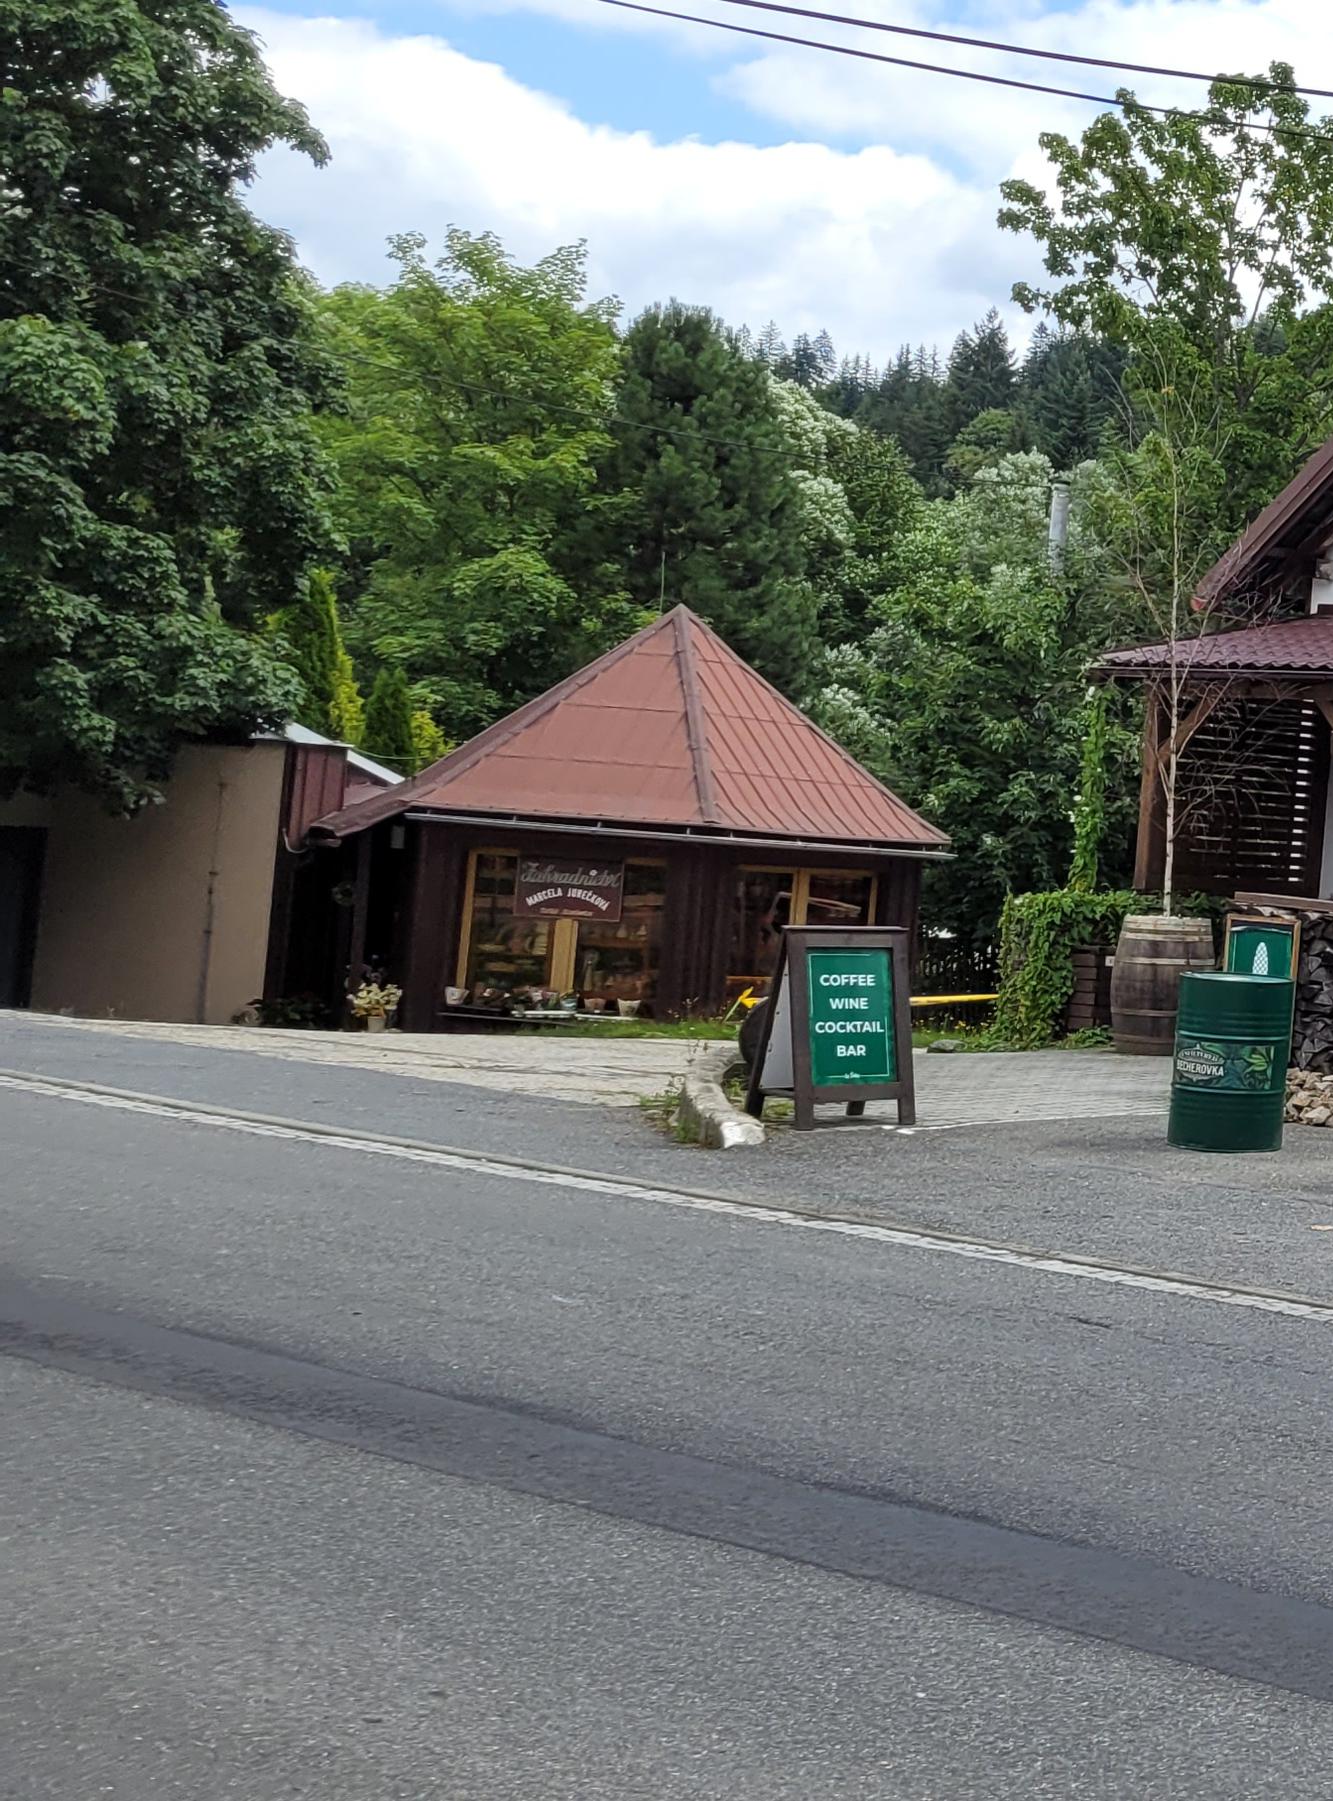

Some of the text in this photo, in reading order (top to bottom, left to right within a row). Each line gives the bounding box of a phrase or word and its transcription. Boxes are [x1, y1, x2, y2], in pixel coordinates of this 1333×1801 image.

[525, 887, 563, 907] MARCELA
[819, 974, 876, 987] COFFEE
[829, 998, 870, 1010] WINE
[814, 1021, 885, 1034] COCKTAIL
[836, 1045, 867, 1057] BAR
